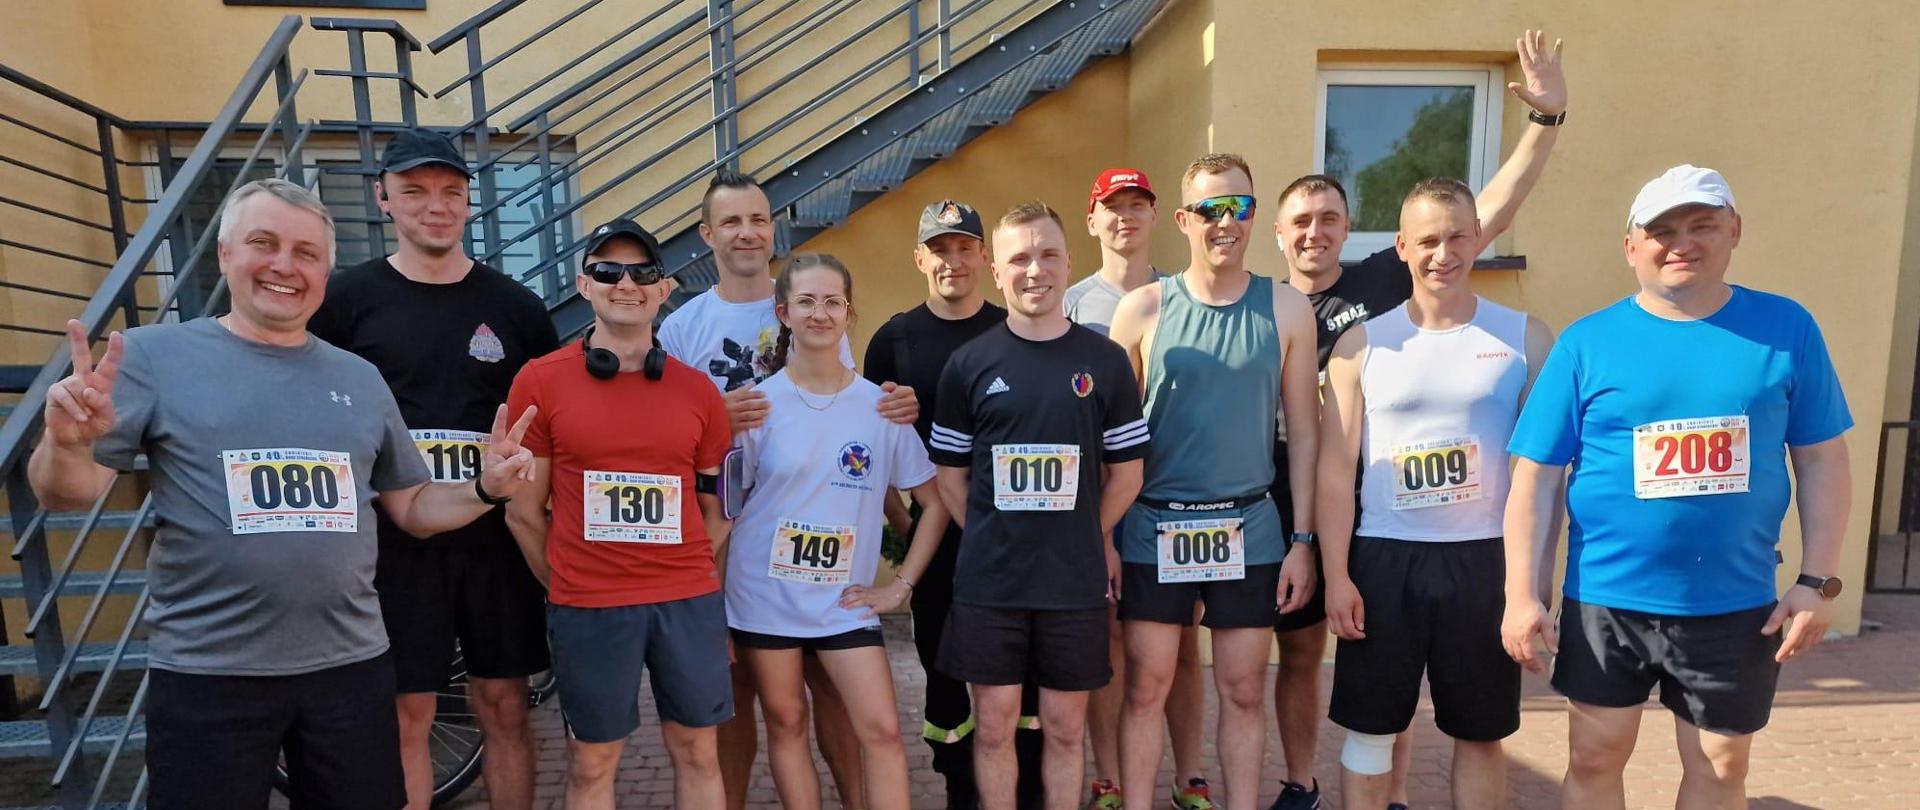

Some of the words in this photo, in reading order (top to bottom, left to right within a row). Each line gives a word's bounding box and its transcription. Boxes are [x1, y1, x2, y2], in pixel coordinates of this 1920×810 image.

[427, 444, 482, 480] 119
[1404, 449, 1467, 491] 009
[1654, 431, 1733, 476] 208
[250, 463, 339, 510] 080
[1010, 457, 1063, 493] 010
[604, 485, 664, 524] 130
[1185, 501, 1235, 511] AROPEC
[790, 533, 840, 569] 149
[1172, 530, 1230, 565] 008
